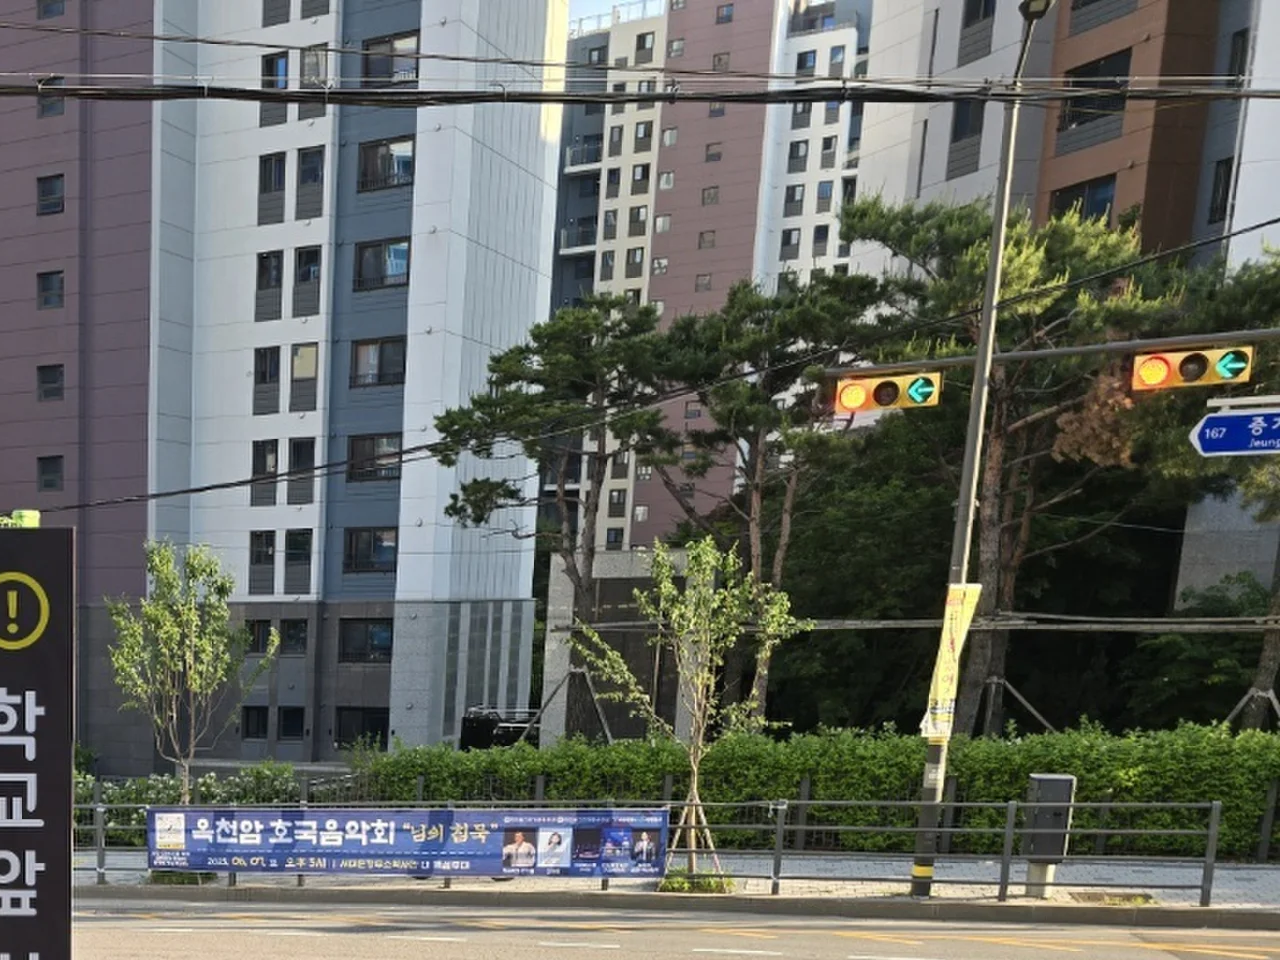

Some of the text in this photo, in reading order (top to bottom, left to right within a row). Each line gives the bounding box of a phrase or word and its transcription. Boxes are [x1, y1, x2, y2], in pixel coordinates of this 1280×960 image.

[1205, 427, 1227, 440] 167
[192, 818, 264, 845] 옥천암
[269, 818, 396, 846] 호국음악회
